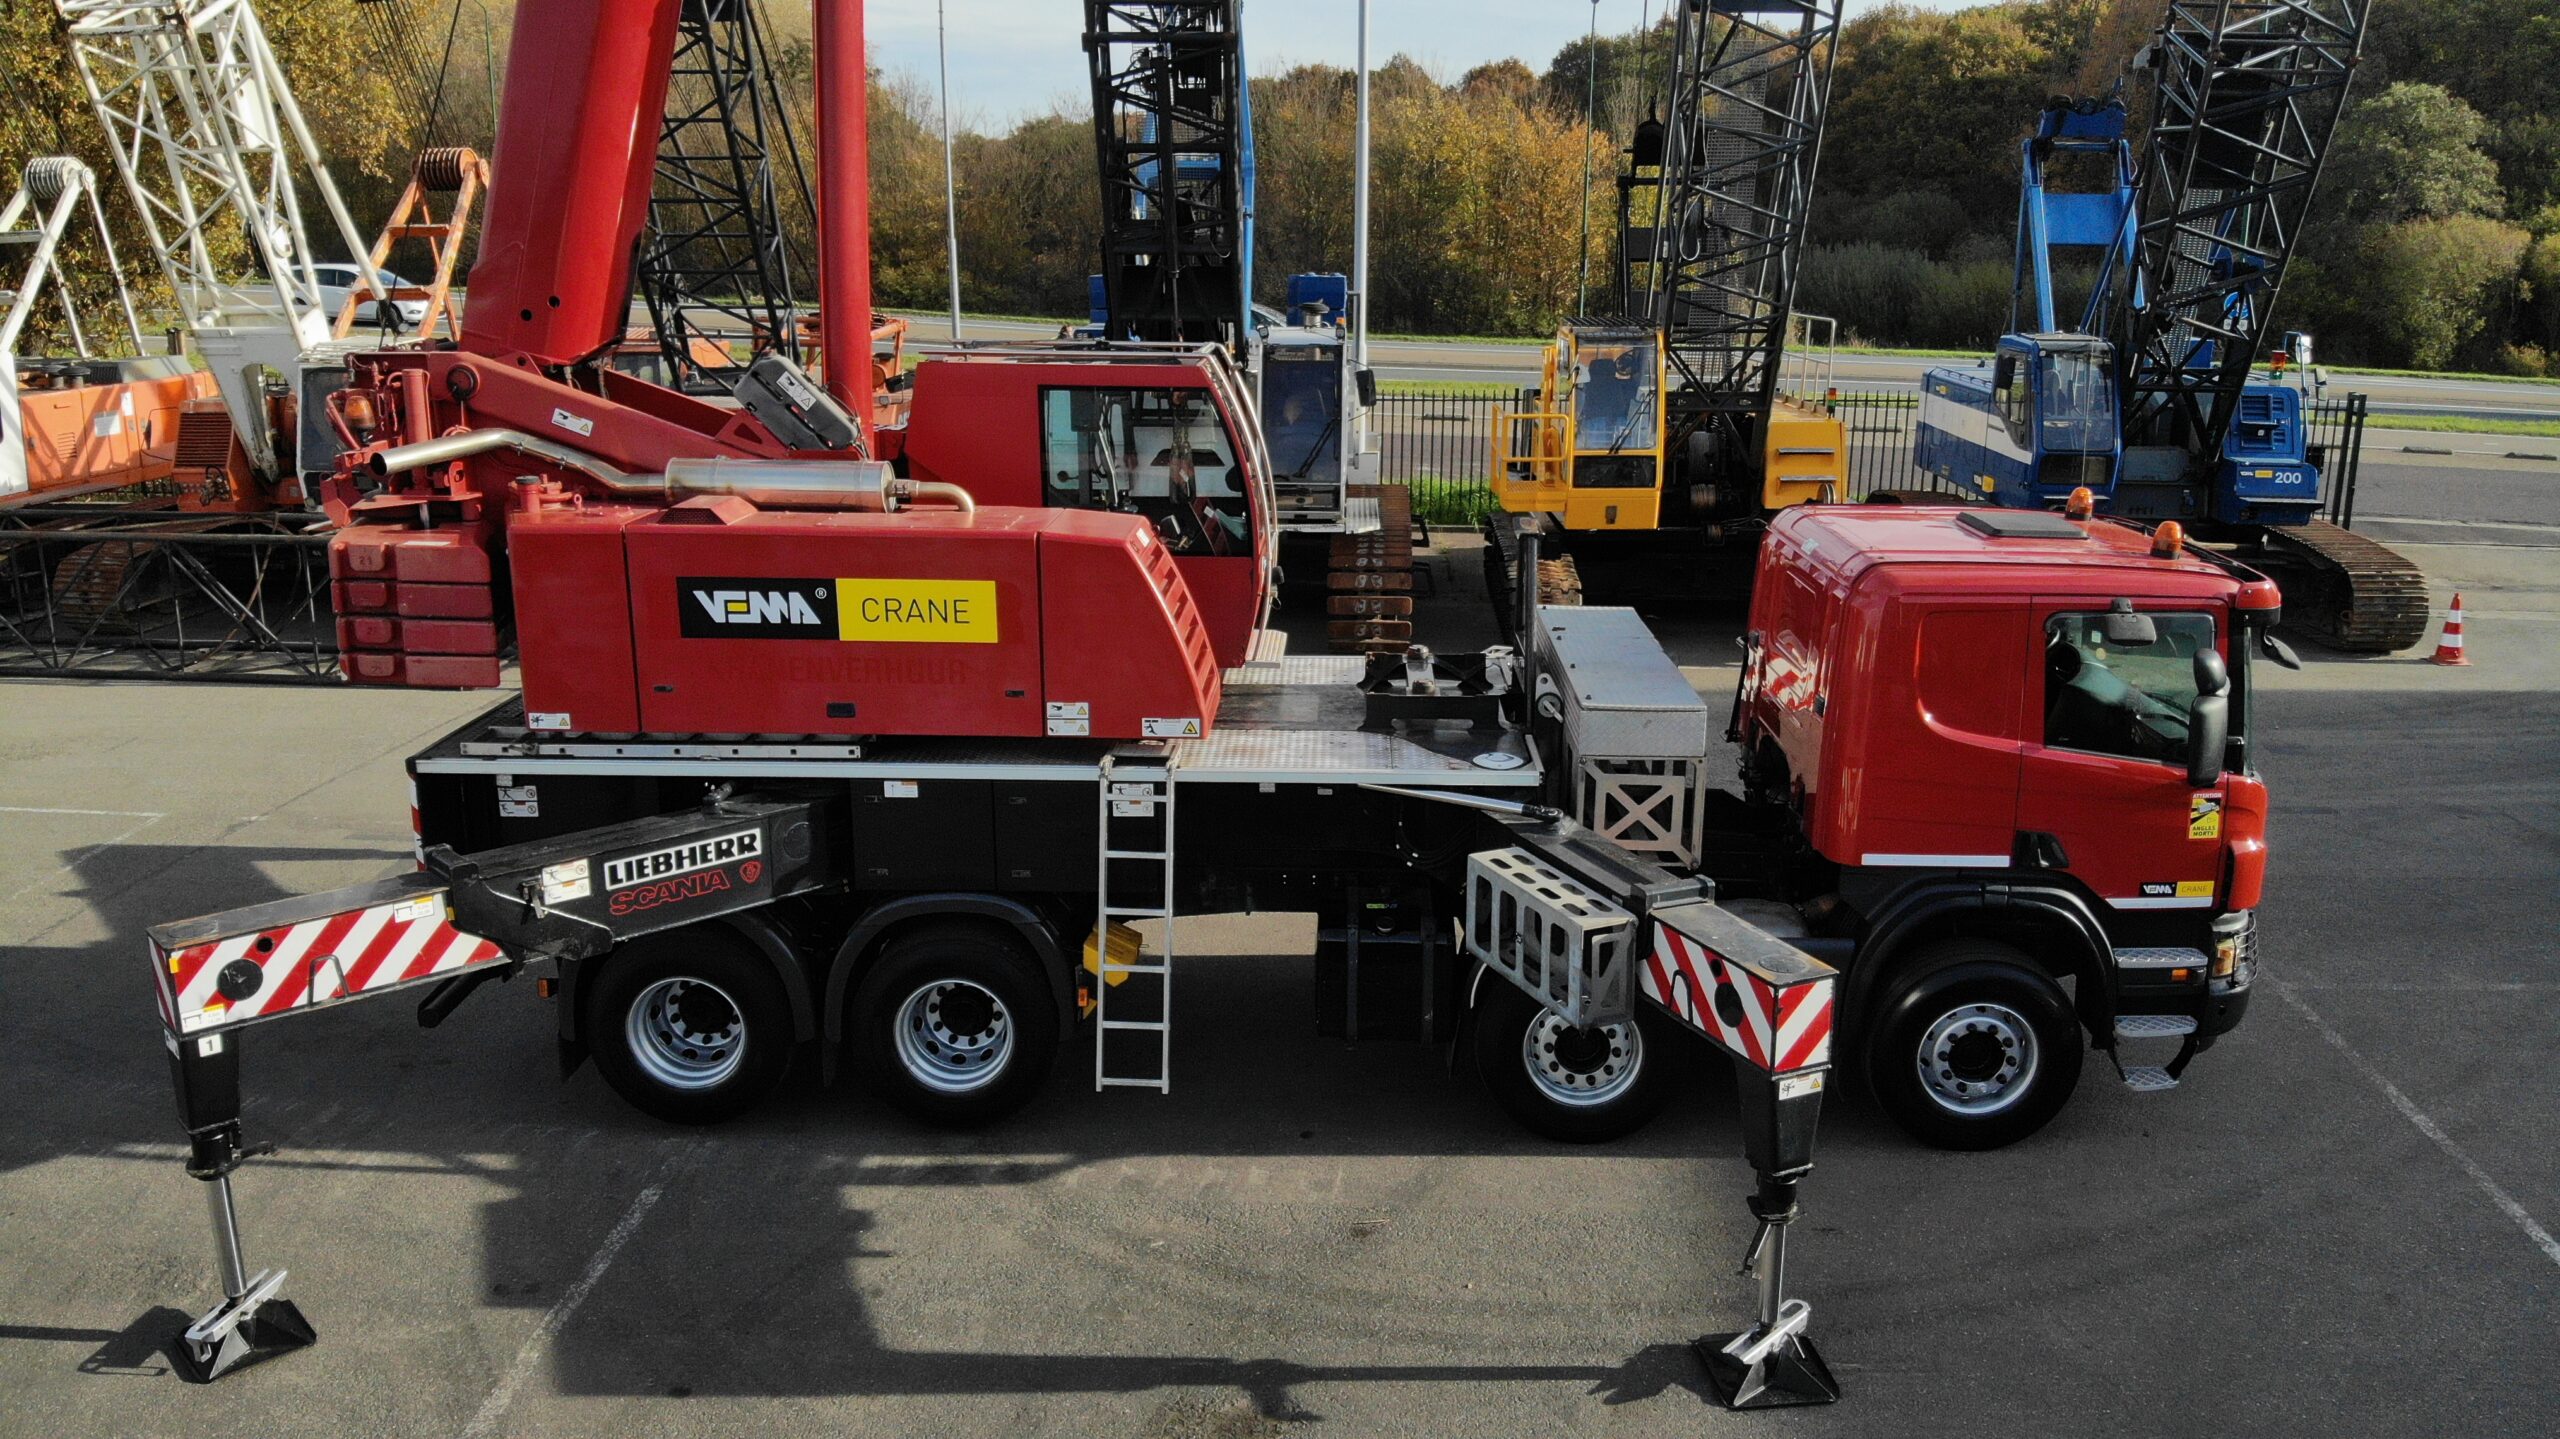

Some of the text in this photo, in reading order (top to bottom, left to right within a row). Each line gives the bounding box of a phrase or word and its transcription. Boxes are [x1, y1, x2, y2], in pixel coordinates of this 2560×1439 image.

[2274, 472, 2302, 484] 200
[861, 598, 970, 624] CRANE
[608, 833, 758, 886] LIEBHERR
[609, 869, 731, 916] SCANIA
[2181, 885, 2208, 894] CRANE
[205, 1039, 213, 1052] 1
